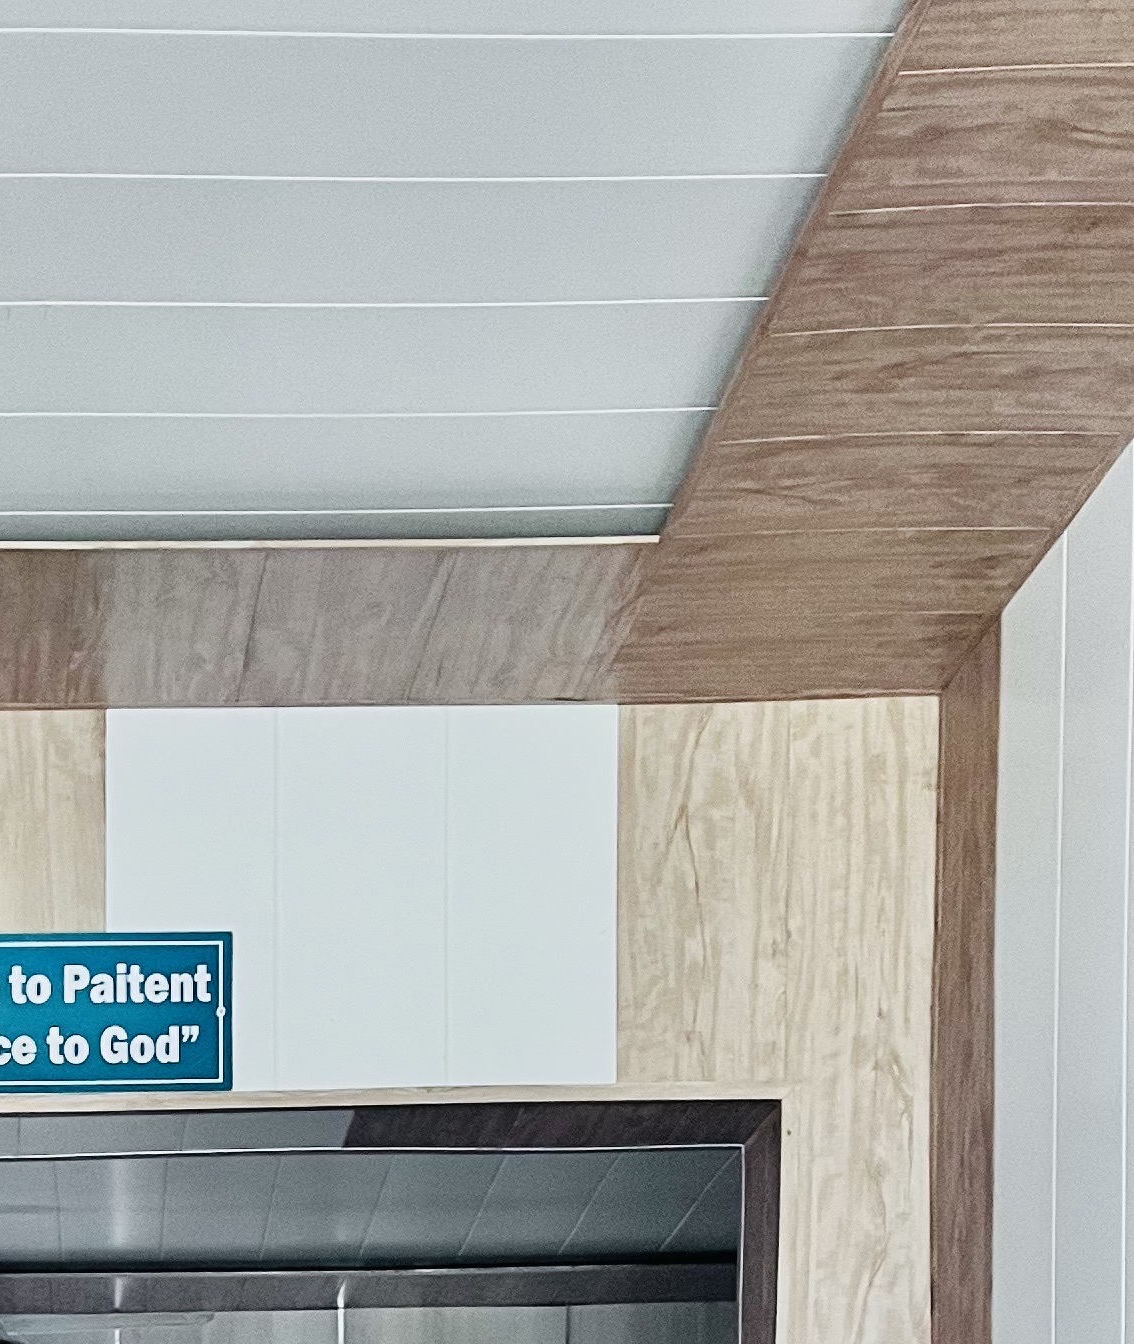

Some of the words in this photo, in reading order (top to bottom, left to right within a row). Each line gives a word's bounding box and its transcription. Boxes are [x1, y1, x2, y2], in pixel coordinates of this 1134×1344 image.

[9, 965, 52, 1005] to
[64, 962, 212, 1004] Paitent
[46, 1026, 90, 1065] to
[100, 1025, 200, 1065] God”
